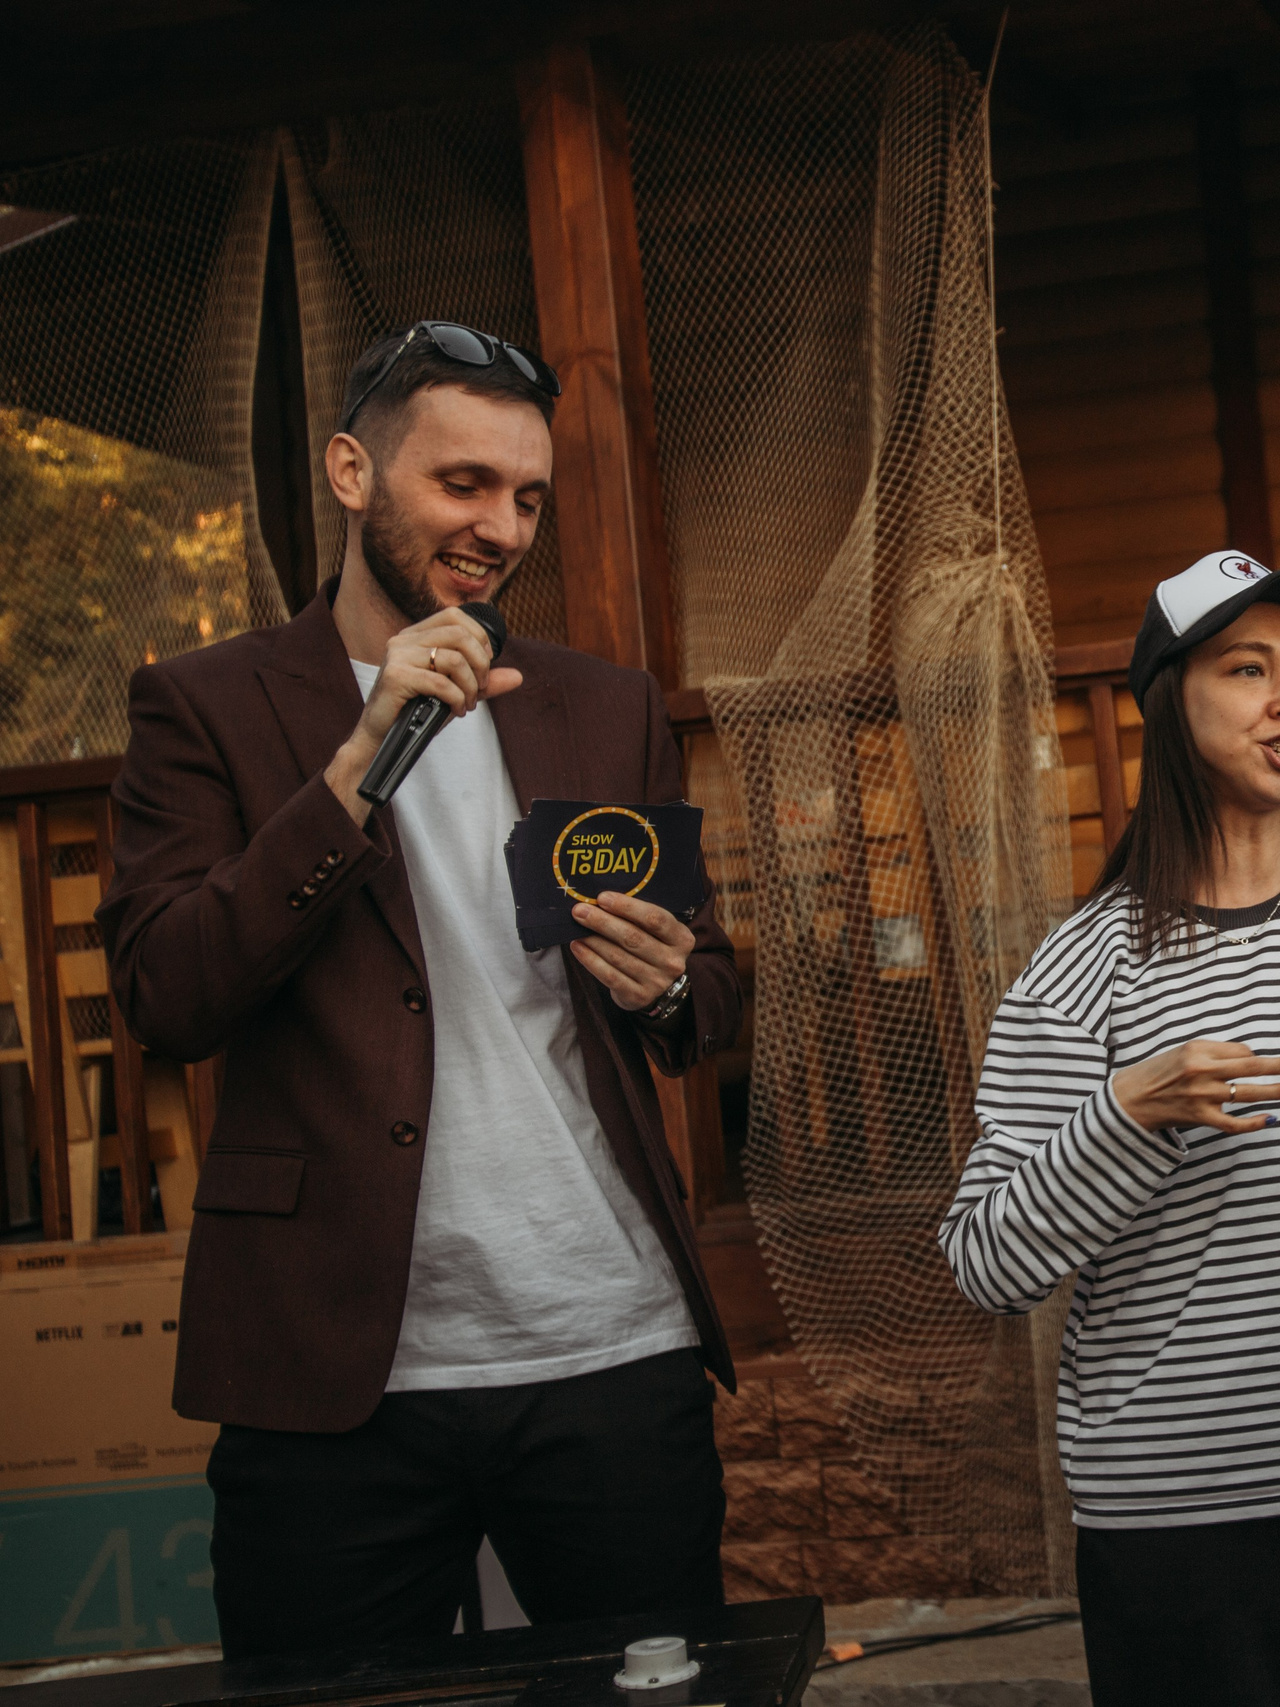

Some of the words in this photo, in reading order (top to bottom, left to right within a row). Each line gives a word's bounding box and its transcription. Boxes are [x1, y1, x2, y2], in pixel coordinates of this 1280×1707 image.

[571, 834, 614, 846] SHOW
[566, 847, 647, 876] TODAY
[36, 1325, 83, 1342] NETFLIX
